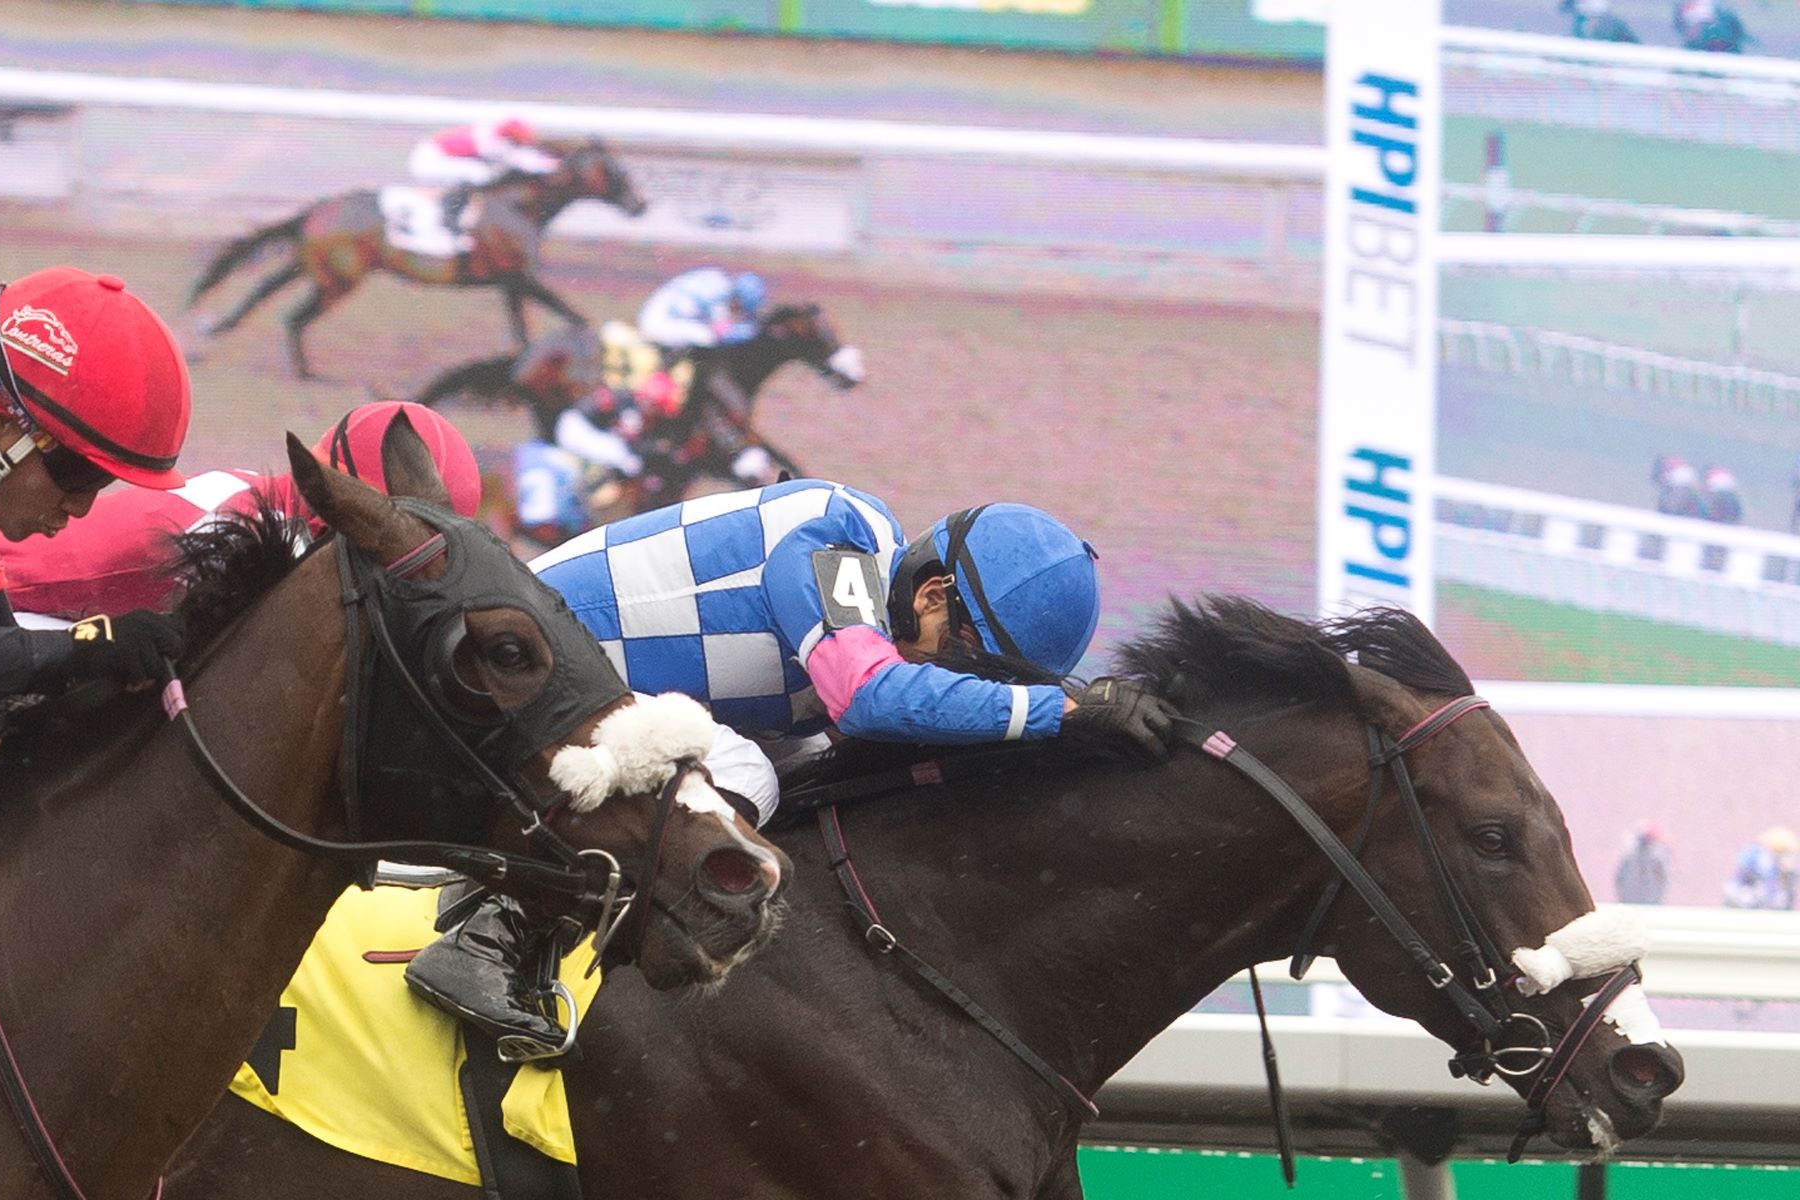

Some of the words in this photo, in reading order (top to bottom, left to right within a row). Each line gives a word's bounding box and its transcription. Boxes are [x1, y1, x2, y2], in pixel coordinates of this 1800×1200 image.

[1345, 70, 1421, 369] HPIBET
[1, 317, 74, 368] Contreras
[1342, 444, 1412, 603] HPI
[832, 557, 877, 626] 4
